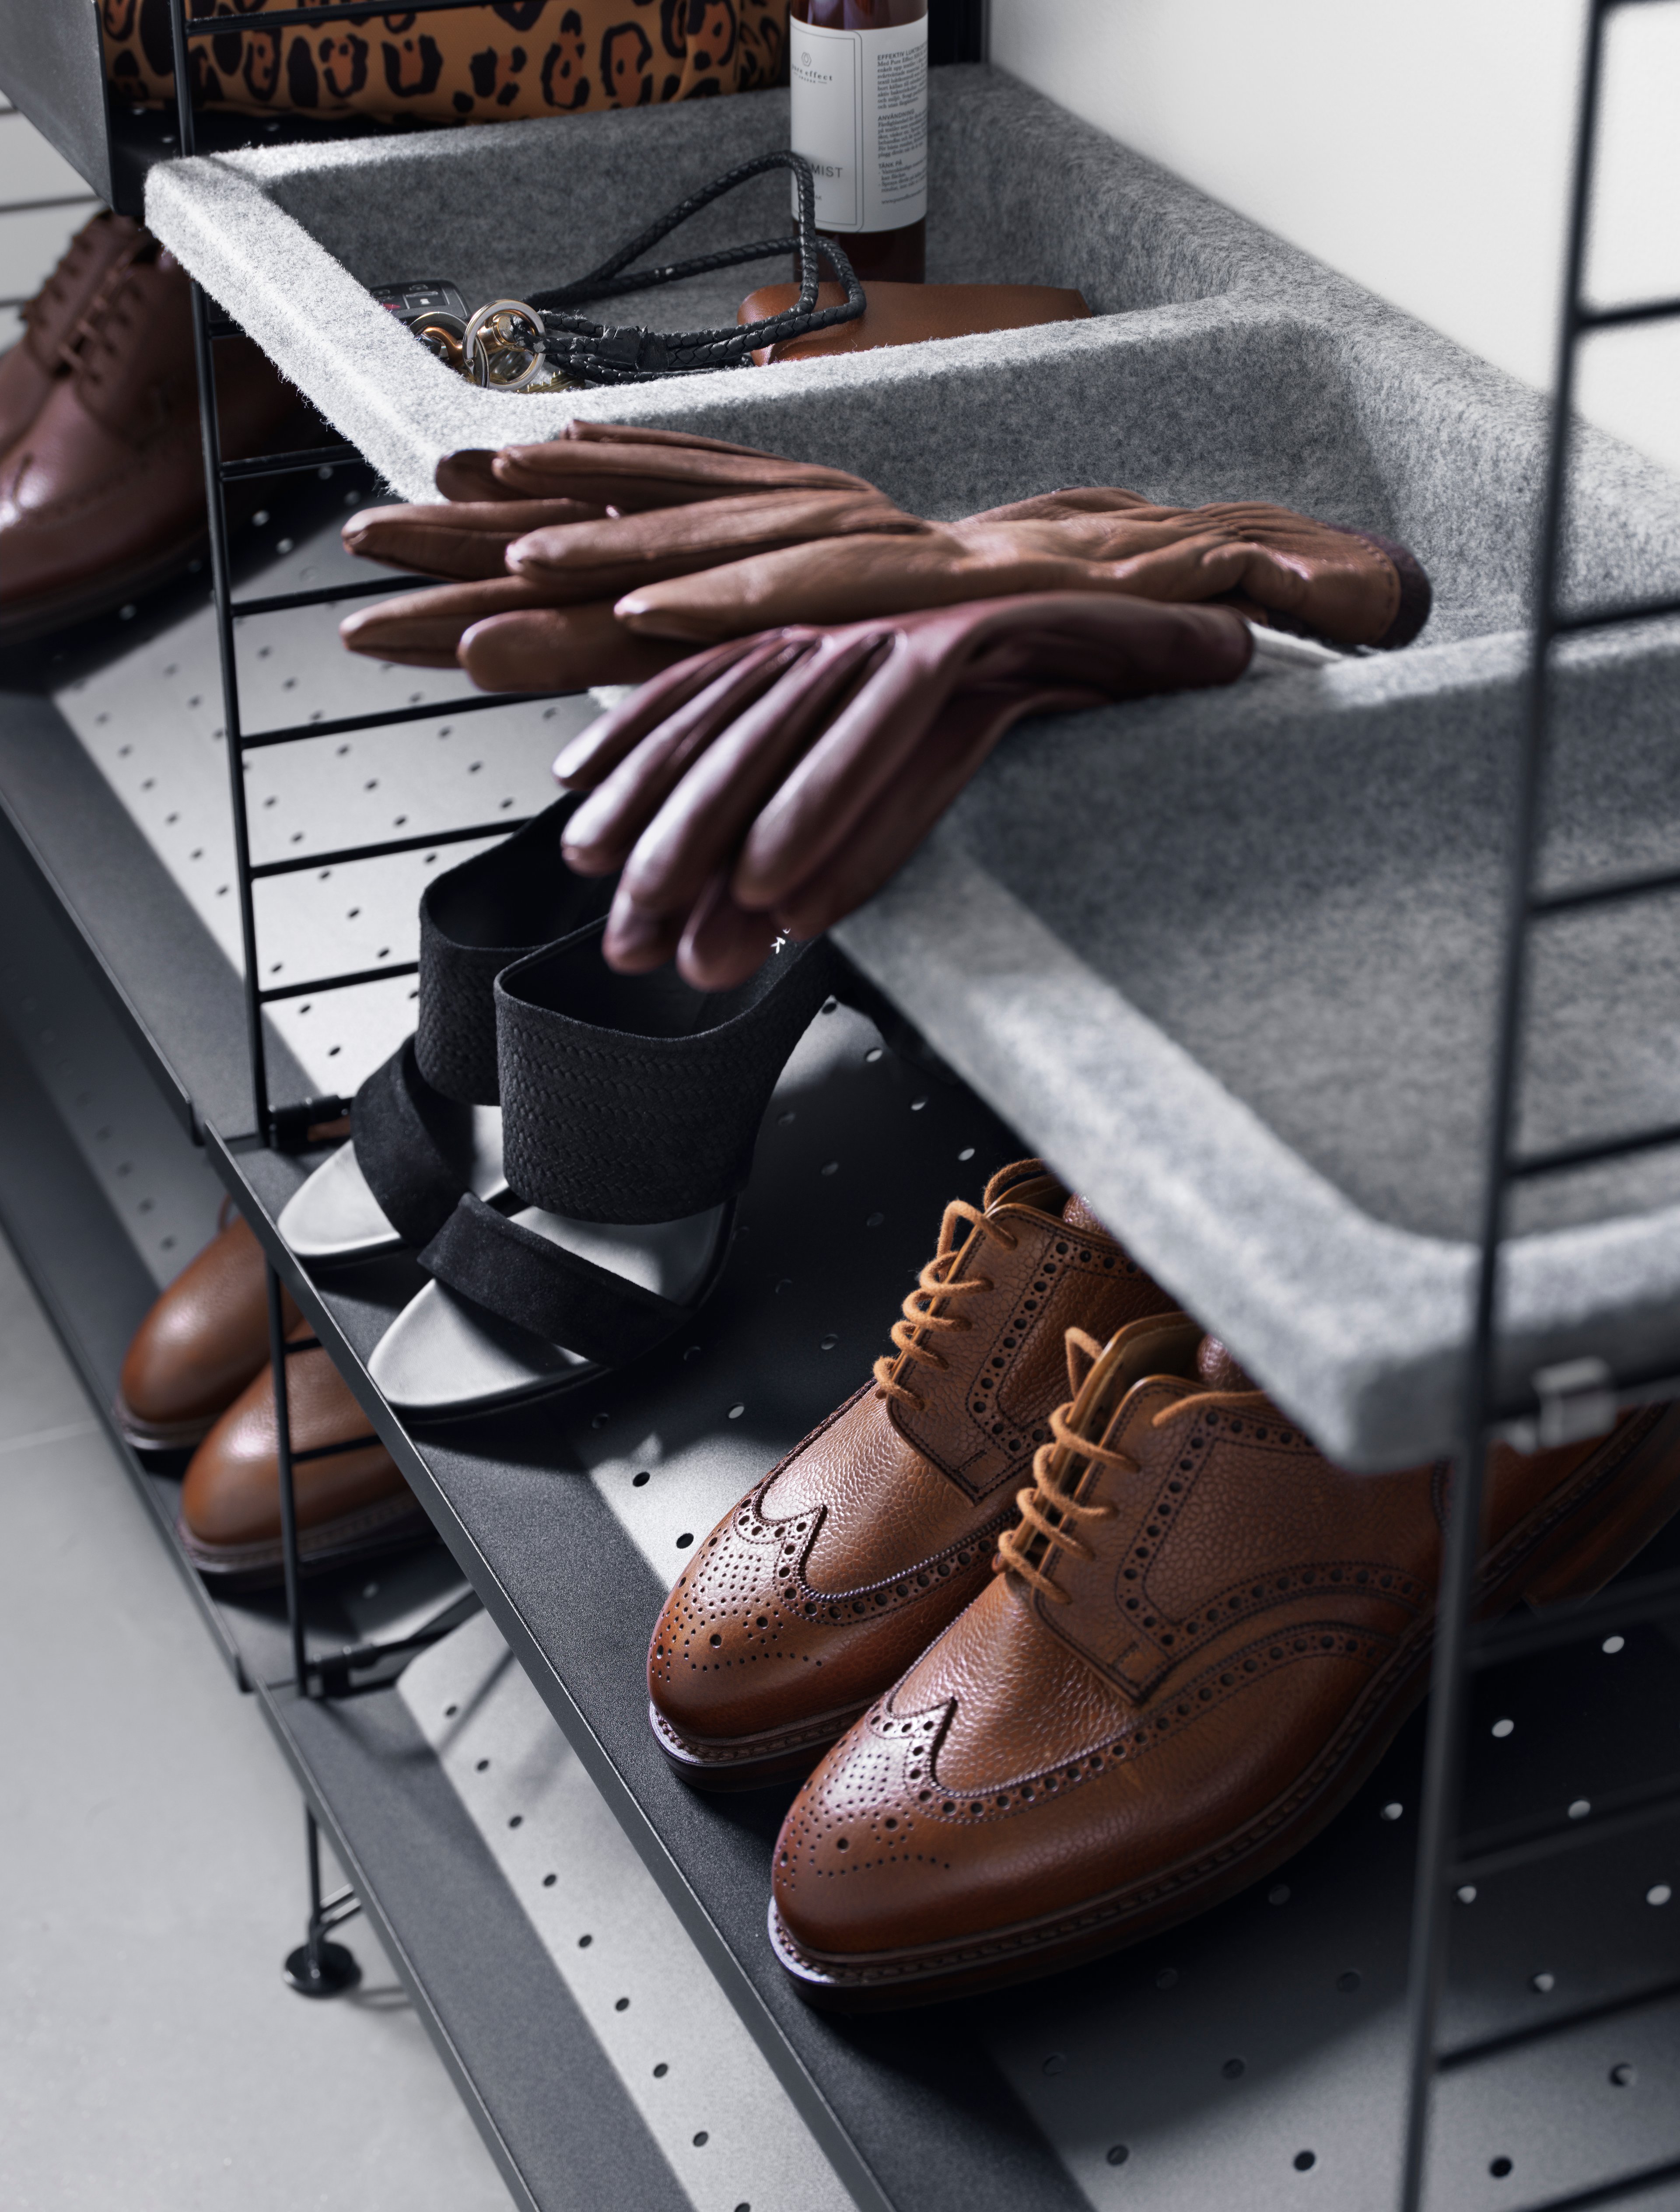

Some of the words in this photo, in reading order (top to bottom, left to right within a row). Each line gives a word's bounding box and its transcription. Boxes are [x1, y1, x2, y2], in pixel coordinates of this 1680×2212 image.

[805, 71, 833, 80] effect
[878, 108, 914, 121] ANVÄNDNING
[812, 164, 843, 177] MIST
